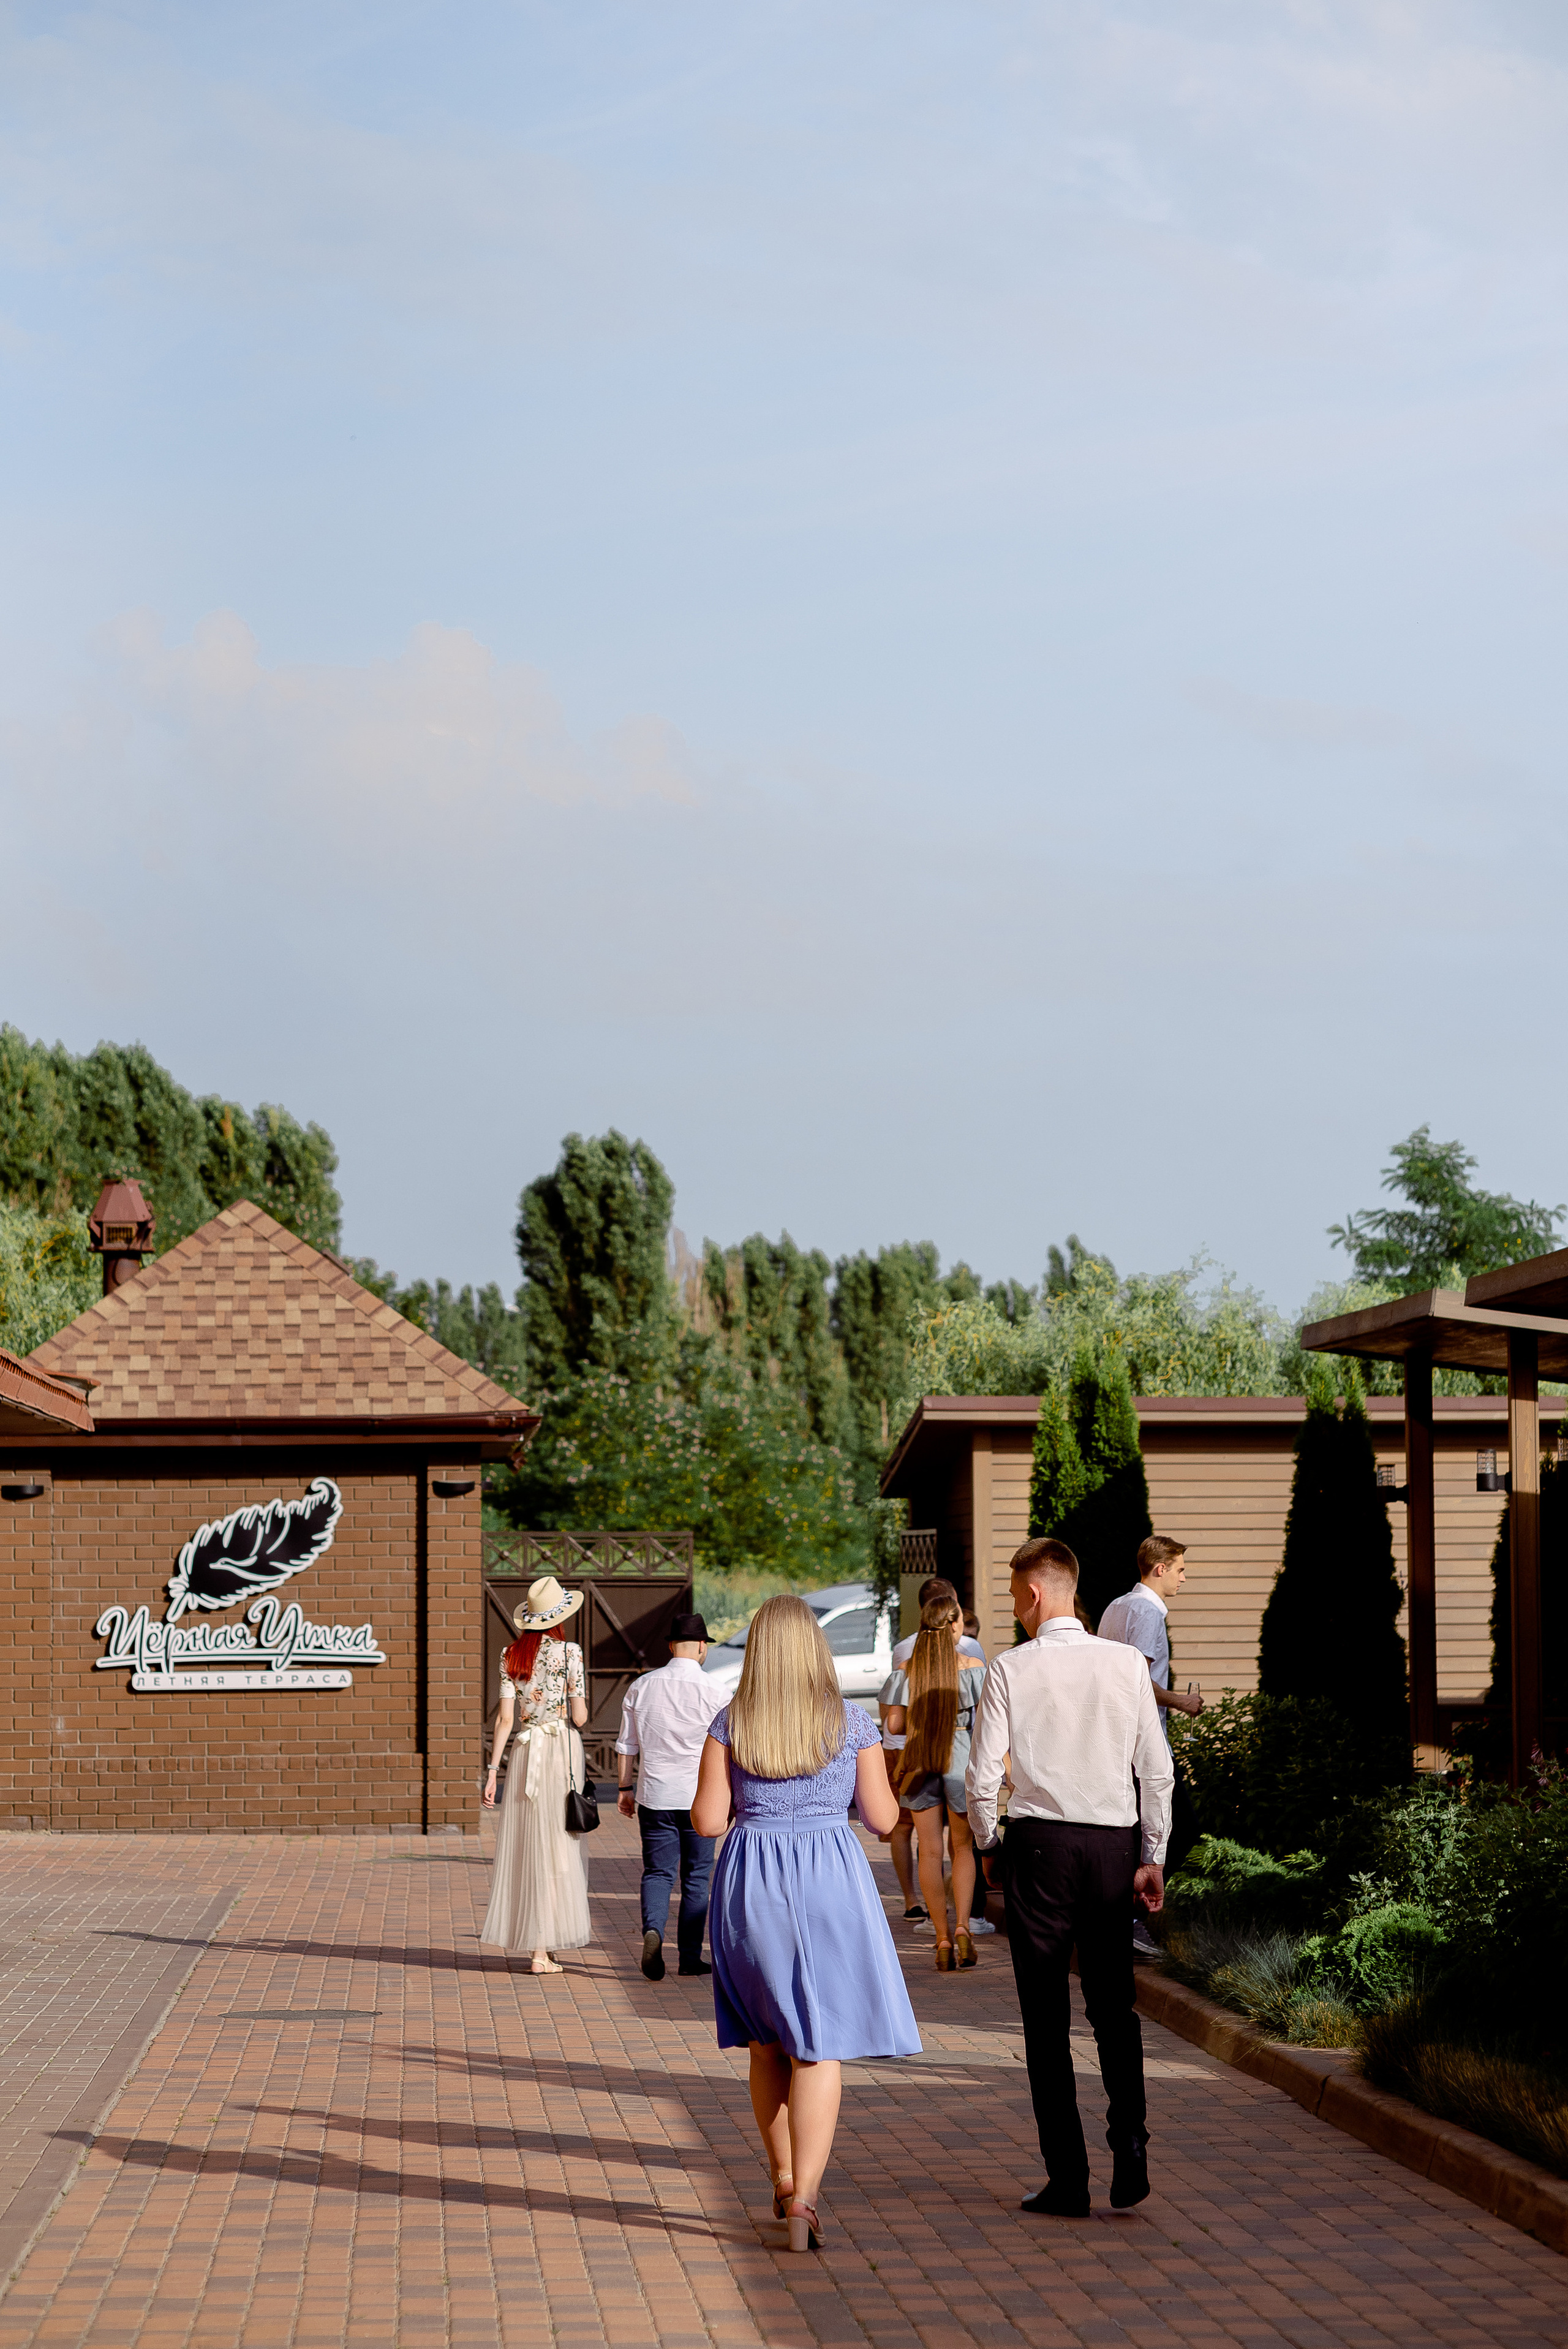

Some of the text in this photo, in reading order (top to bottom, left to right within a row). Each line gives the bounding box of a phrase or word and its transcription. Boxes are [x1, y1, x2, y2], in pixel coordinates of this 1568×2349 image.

[247, 1595, 379, 1672] Утка
[135, 1674, 349, 1687] ЛЕТНЯЯ ТЕРРАСА
